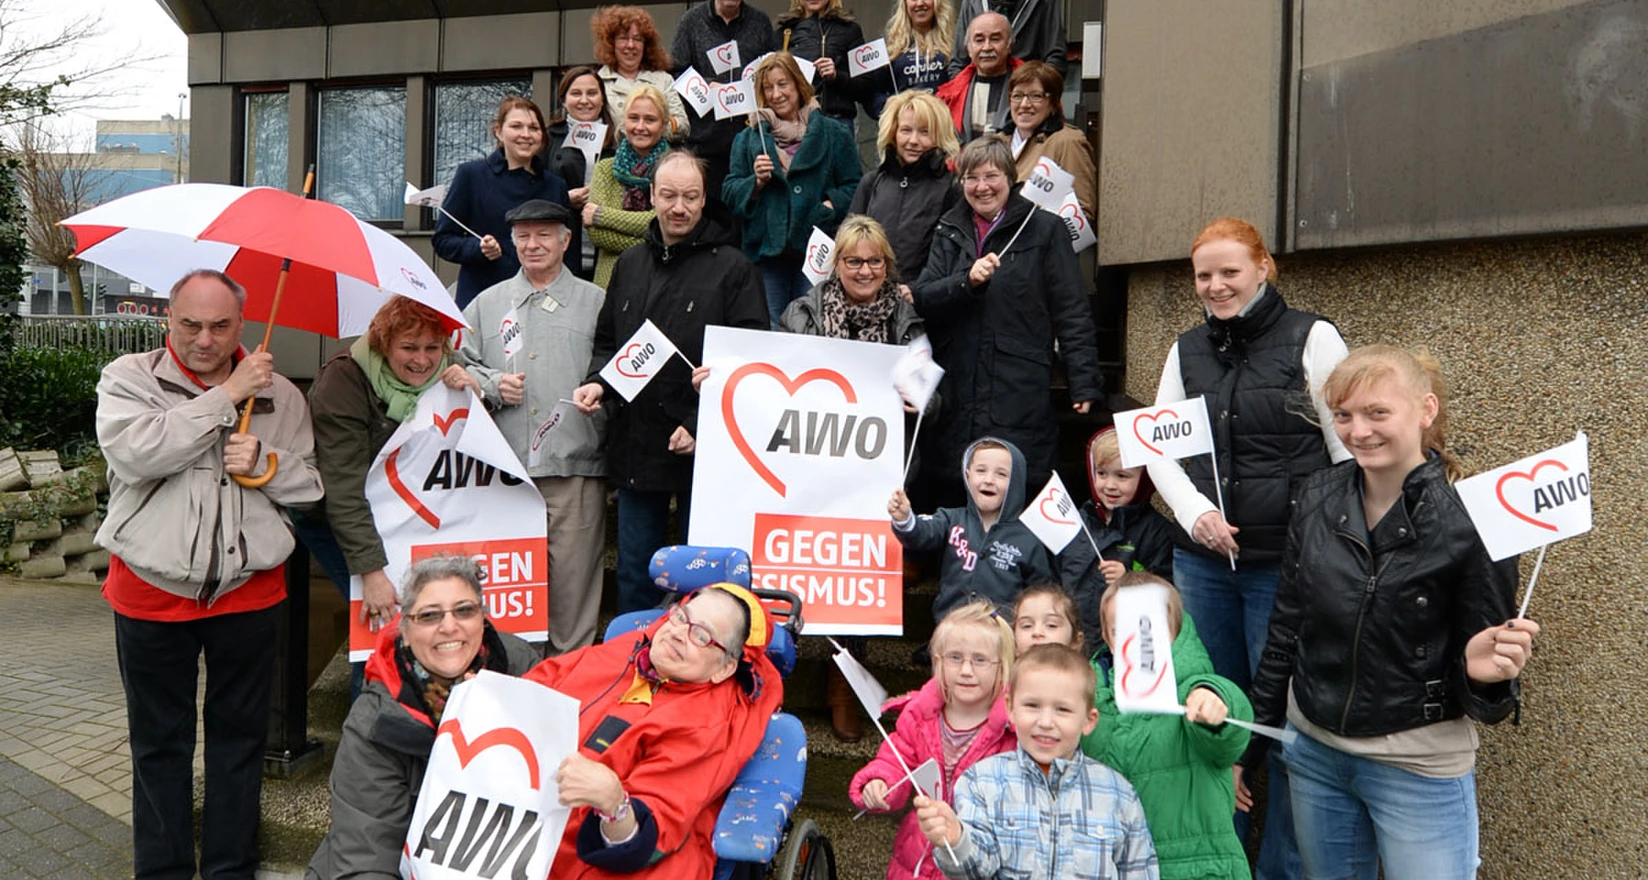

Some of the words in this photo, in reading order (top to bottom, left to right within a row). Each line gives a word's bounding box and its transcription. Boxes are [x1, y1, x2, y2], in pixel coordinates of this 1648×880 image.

[725, 92, 745, 105] AWO
[576, 130, 597, 142] AWO
[630, 342, 656, 372] AWO
[766, 409, 888, 460] AWO
[1152, 420, 1193, 443] AWO
[1533, 472, 1589, 514] AWO
[764, 528, 887, 569] GEGEN
